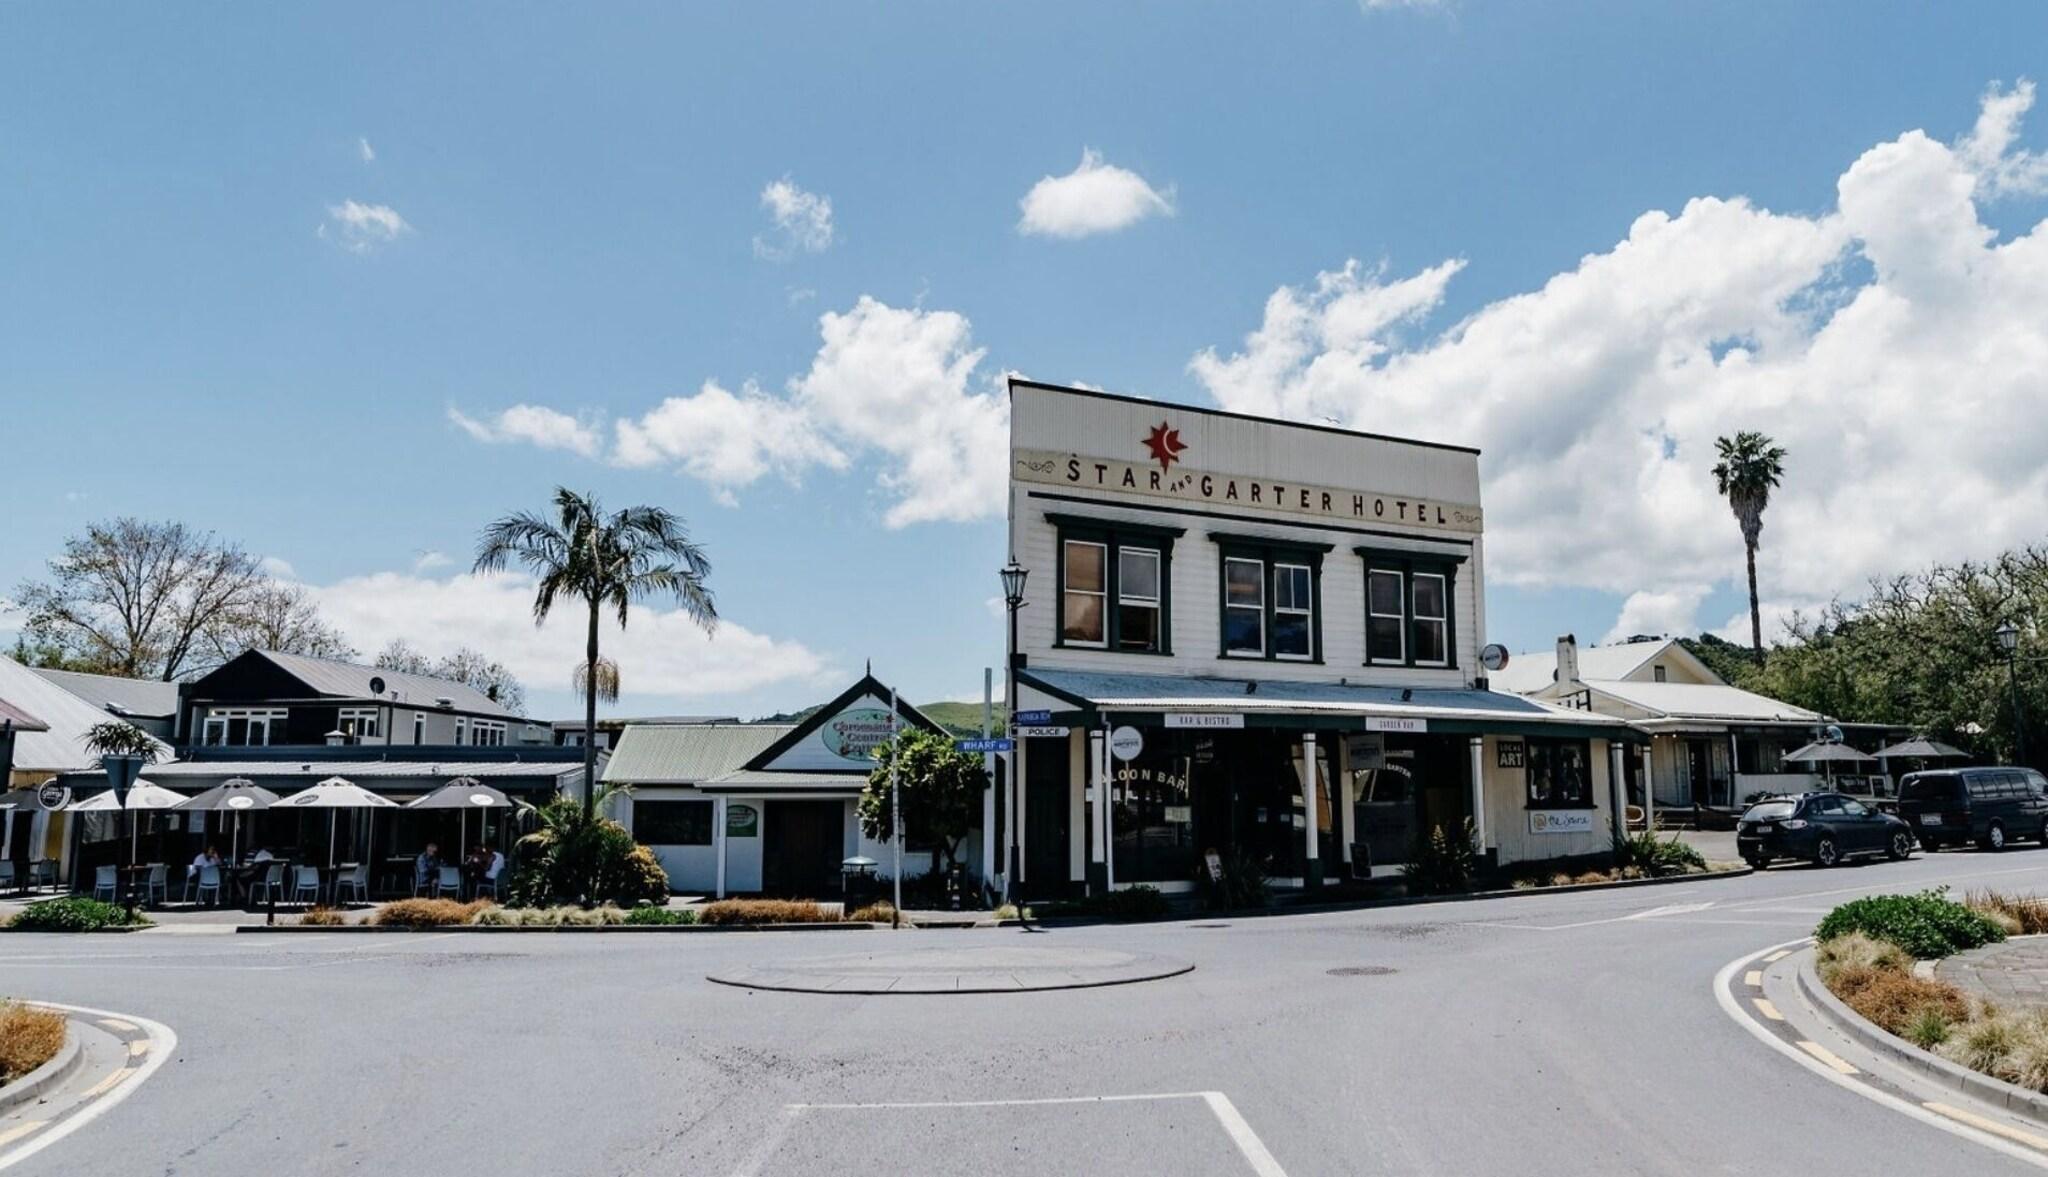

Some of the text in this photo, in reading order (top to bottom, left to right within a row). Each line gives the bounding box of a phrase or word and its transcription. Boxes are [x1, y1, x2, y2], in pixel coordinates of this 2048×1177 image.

[1066, 458, 1446, 524] STAR AND GARTER HOTEL
[1028, 727, 1060, 736] POLICE
[963, 741, 997, 751] WHARF
[1499, 752, 1523, 766] ART
[1157, 771, 1186, 792] BAR
